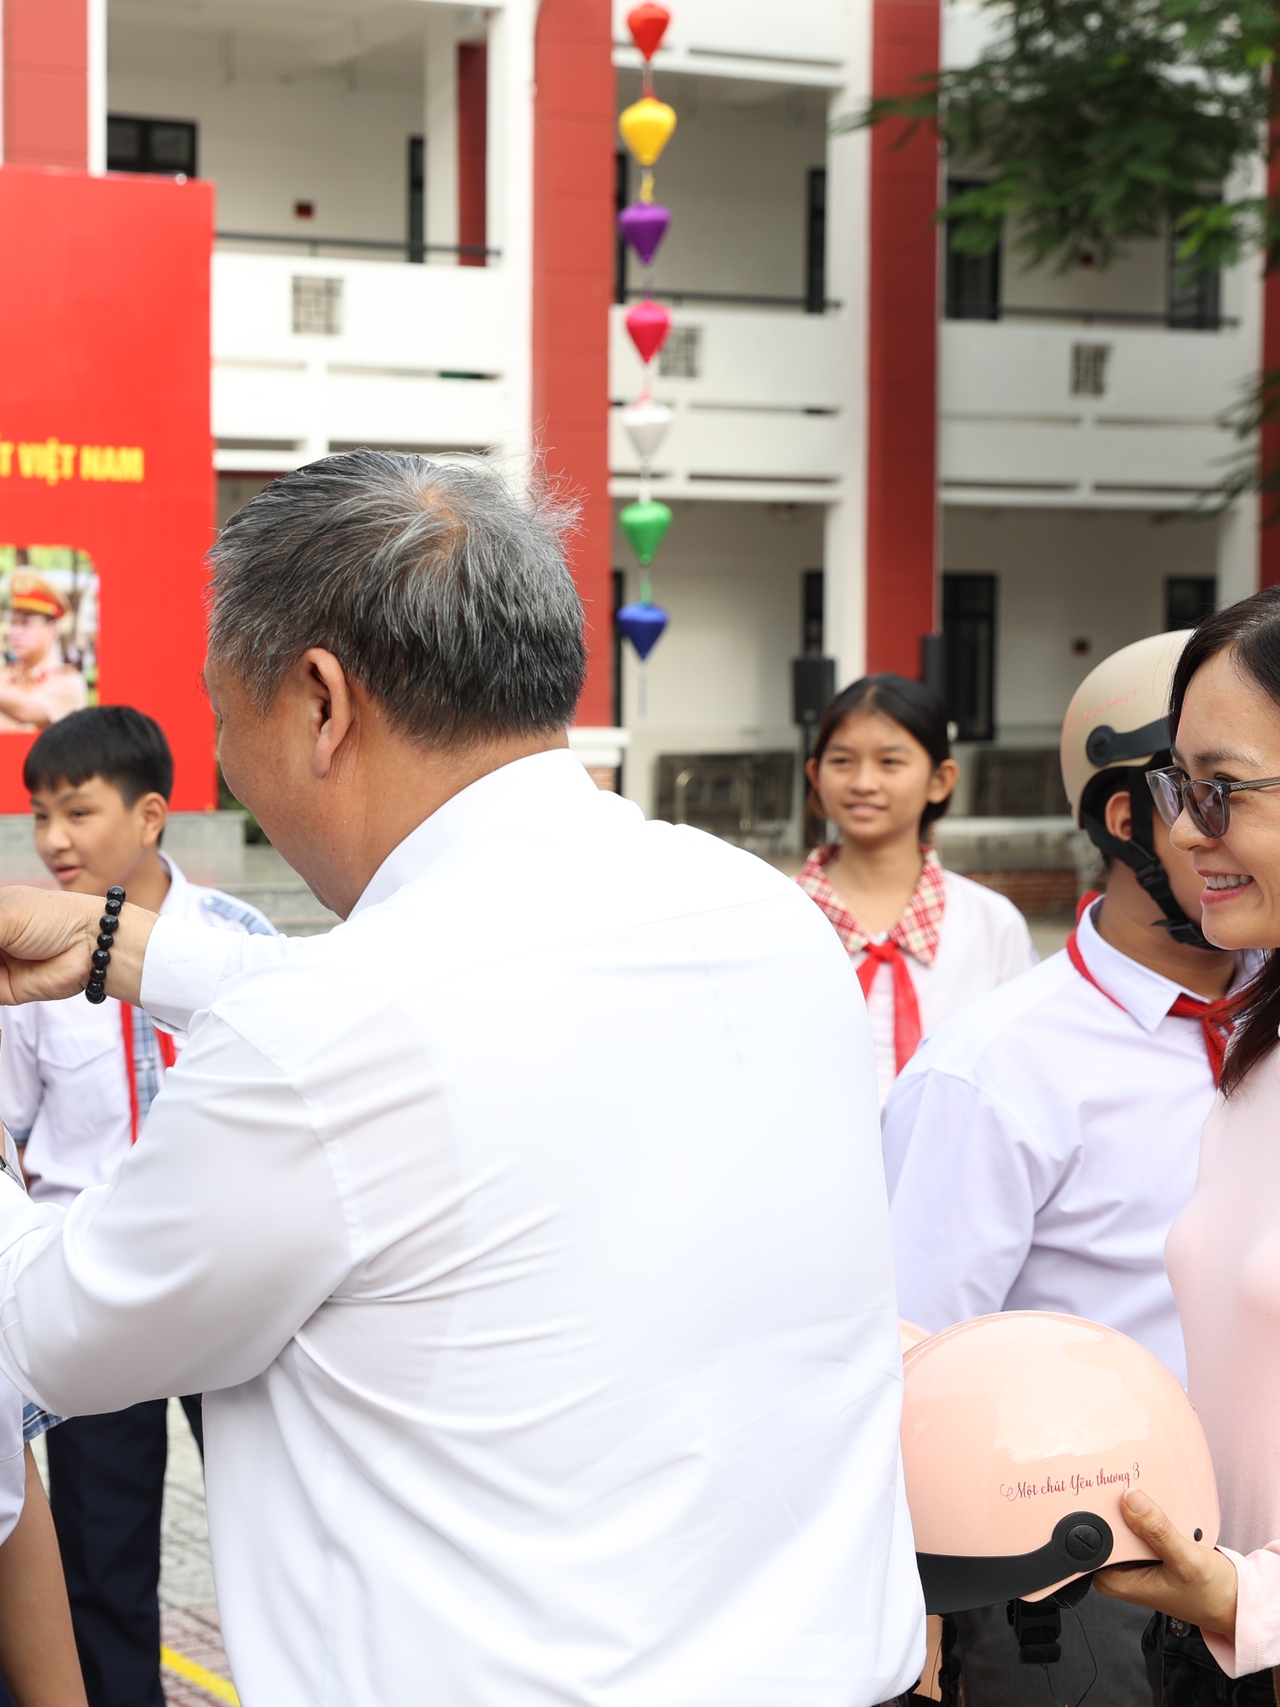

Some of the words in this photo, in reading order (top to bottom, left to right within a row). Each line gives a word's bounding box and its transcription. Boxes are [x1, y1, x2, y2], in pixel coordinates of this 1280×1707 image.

[17, 438, 76, 486] VIỆT
[80, 446, 144, 482] NAM
[999, 1481, 1038, 1501] Một
[1040, 1476, 1066, 1494] chút
[1070, 1473, 1094, 1496] Yêu
[1096, 1467, 1131, 1491] thương
[1132, 1462, 1140, 1480] 3
